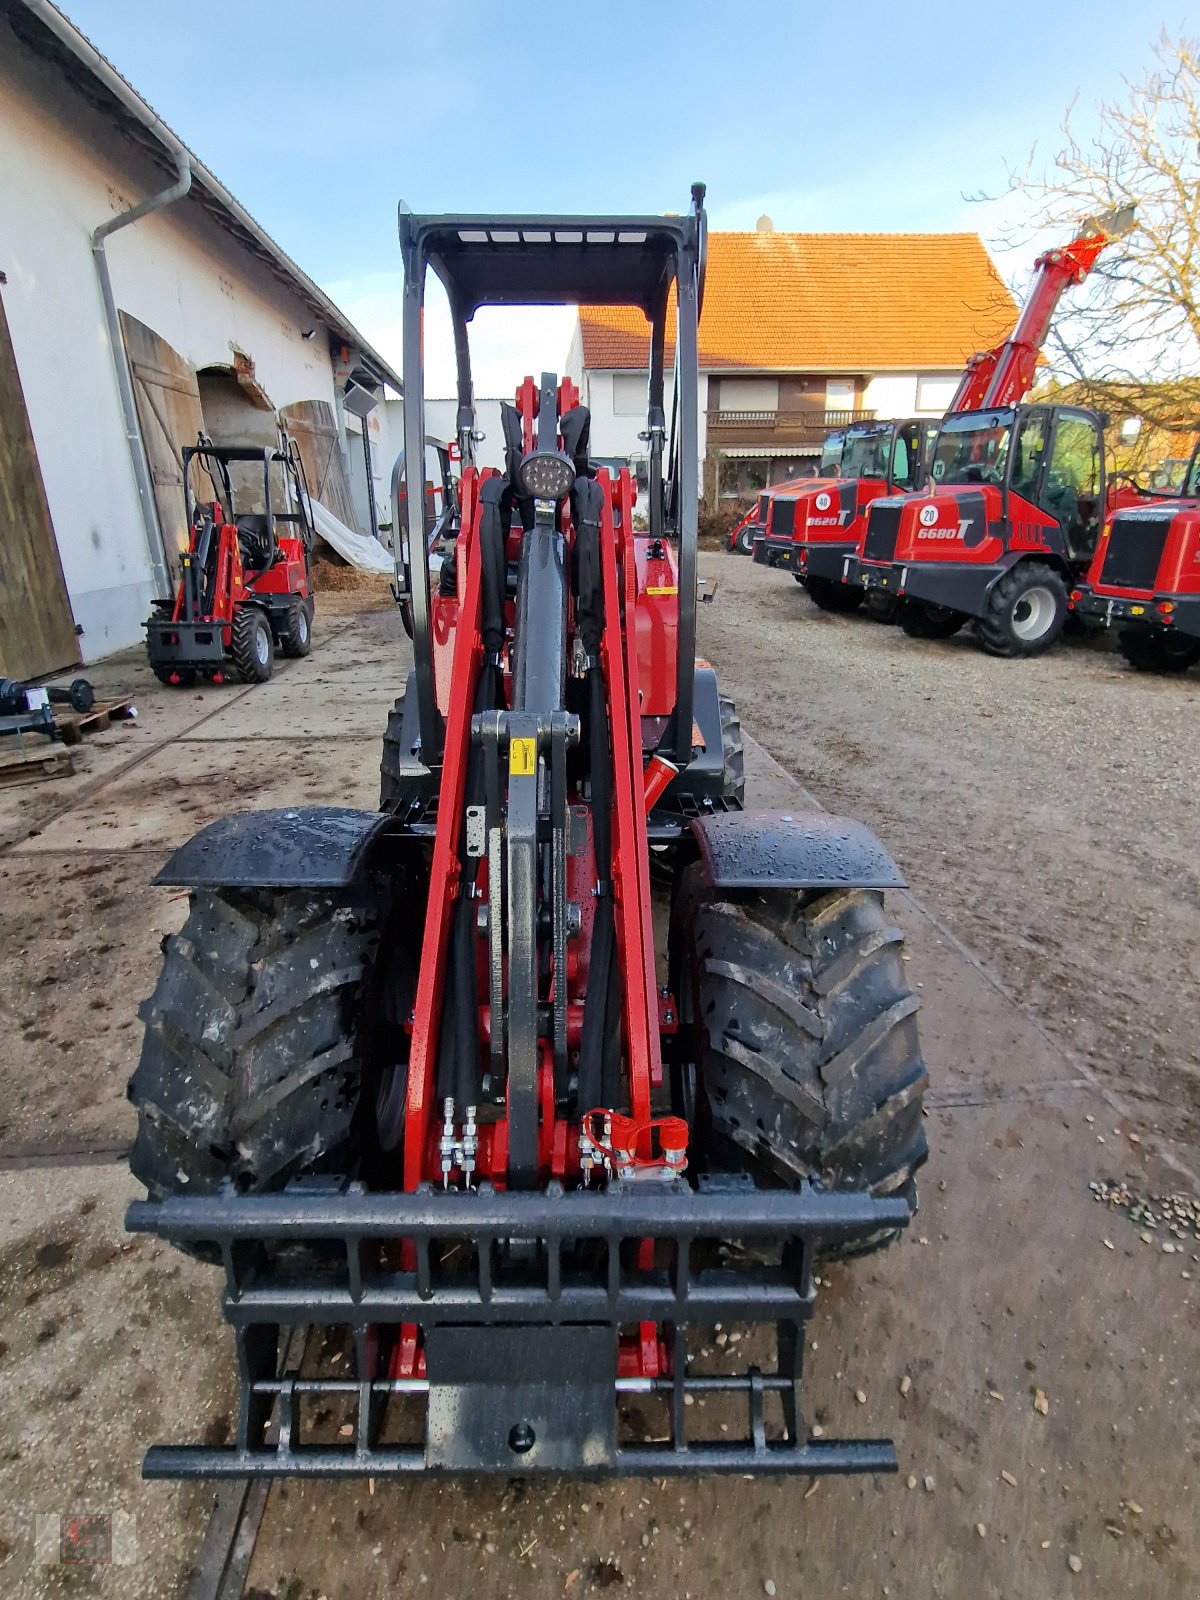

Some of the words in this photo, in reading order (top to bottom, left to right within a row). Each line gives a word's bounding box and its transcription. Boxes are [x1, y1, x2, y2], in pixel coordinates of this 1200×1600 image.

[818, 497, 828, 507] 40
[923, 509, 935, 522] 20
[917, 519, 975, 540] 6680T
